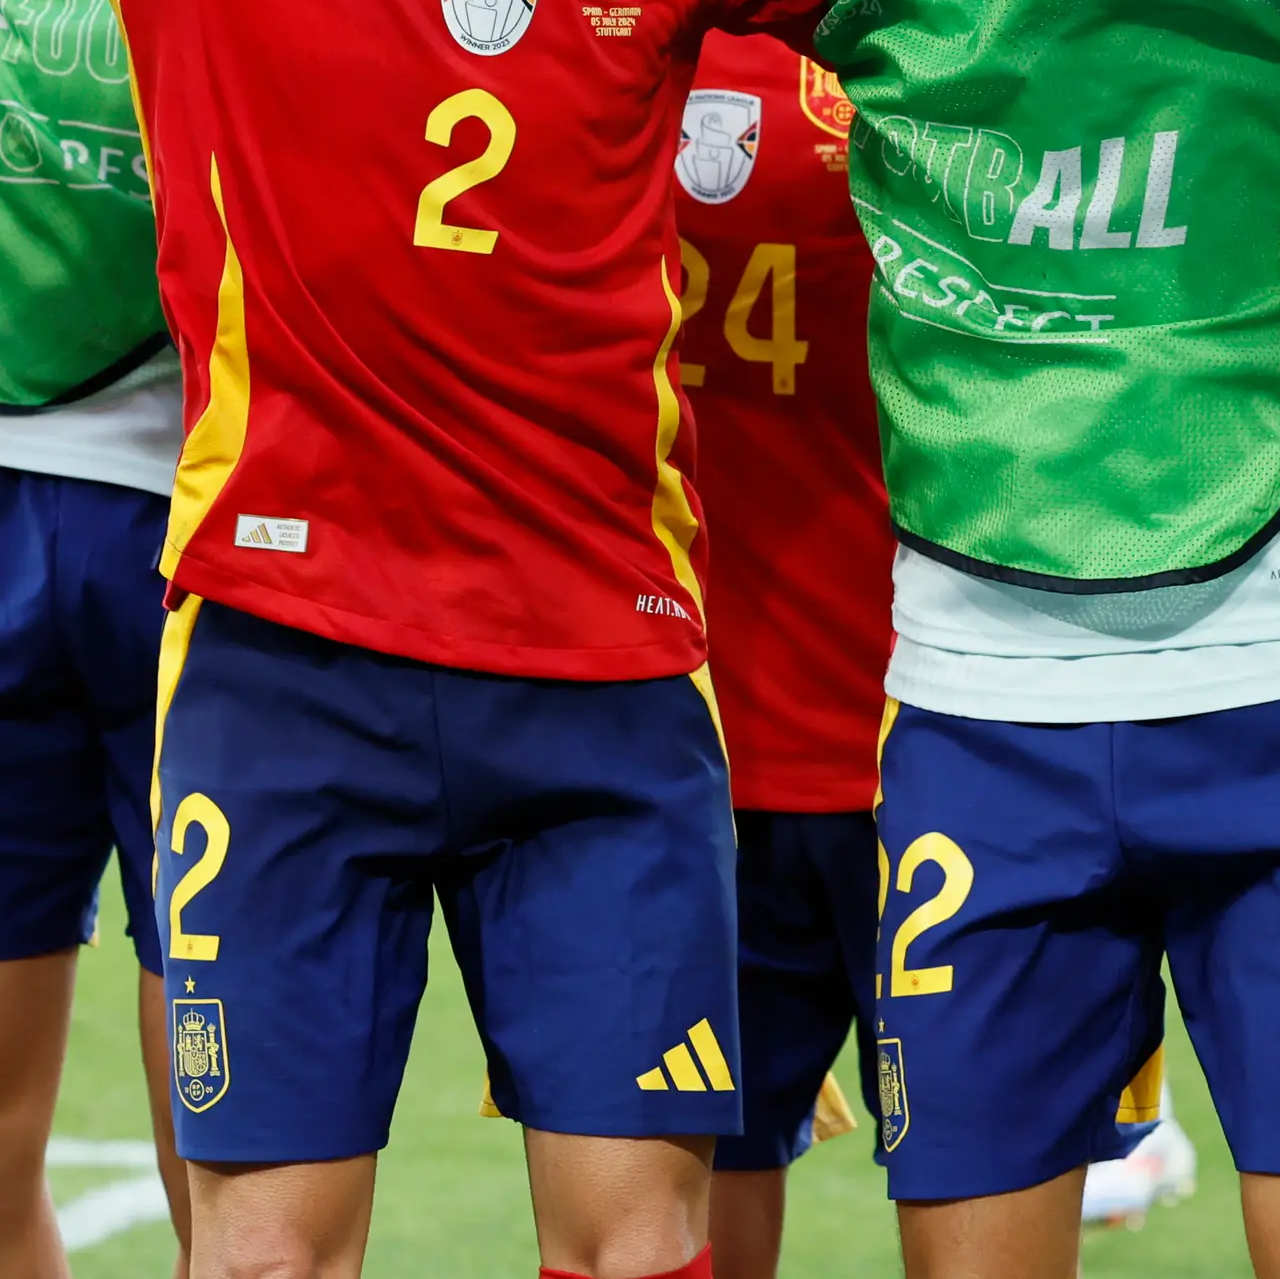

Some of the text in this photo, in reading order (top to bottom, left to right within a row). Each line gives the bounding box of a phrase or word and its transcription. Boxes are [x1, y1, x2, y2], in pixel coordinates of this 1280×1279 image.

[582, 6, 603, 16] SPAIN
[609, 7, 642, 17] GERMANY
[590, 17, 636, 26] 05 JULY 2024
[595, 27, 632, 37] STUTTGART
[461, 33, 511, 51] WINNER 2023
[413, 88, 517, 255] 2
[169, 791, 231, 962] 2
[875, 831, 974, 999] 2
